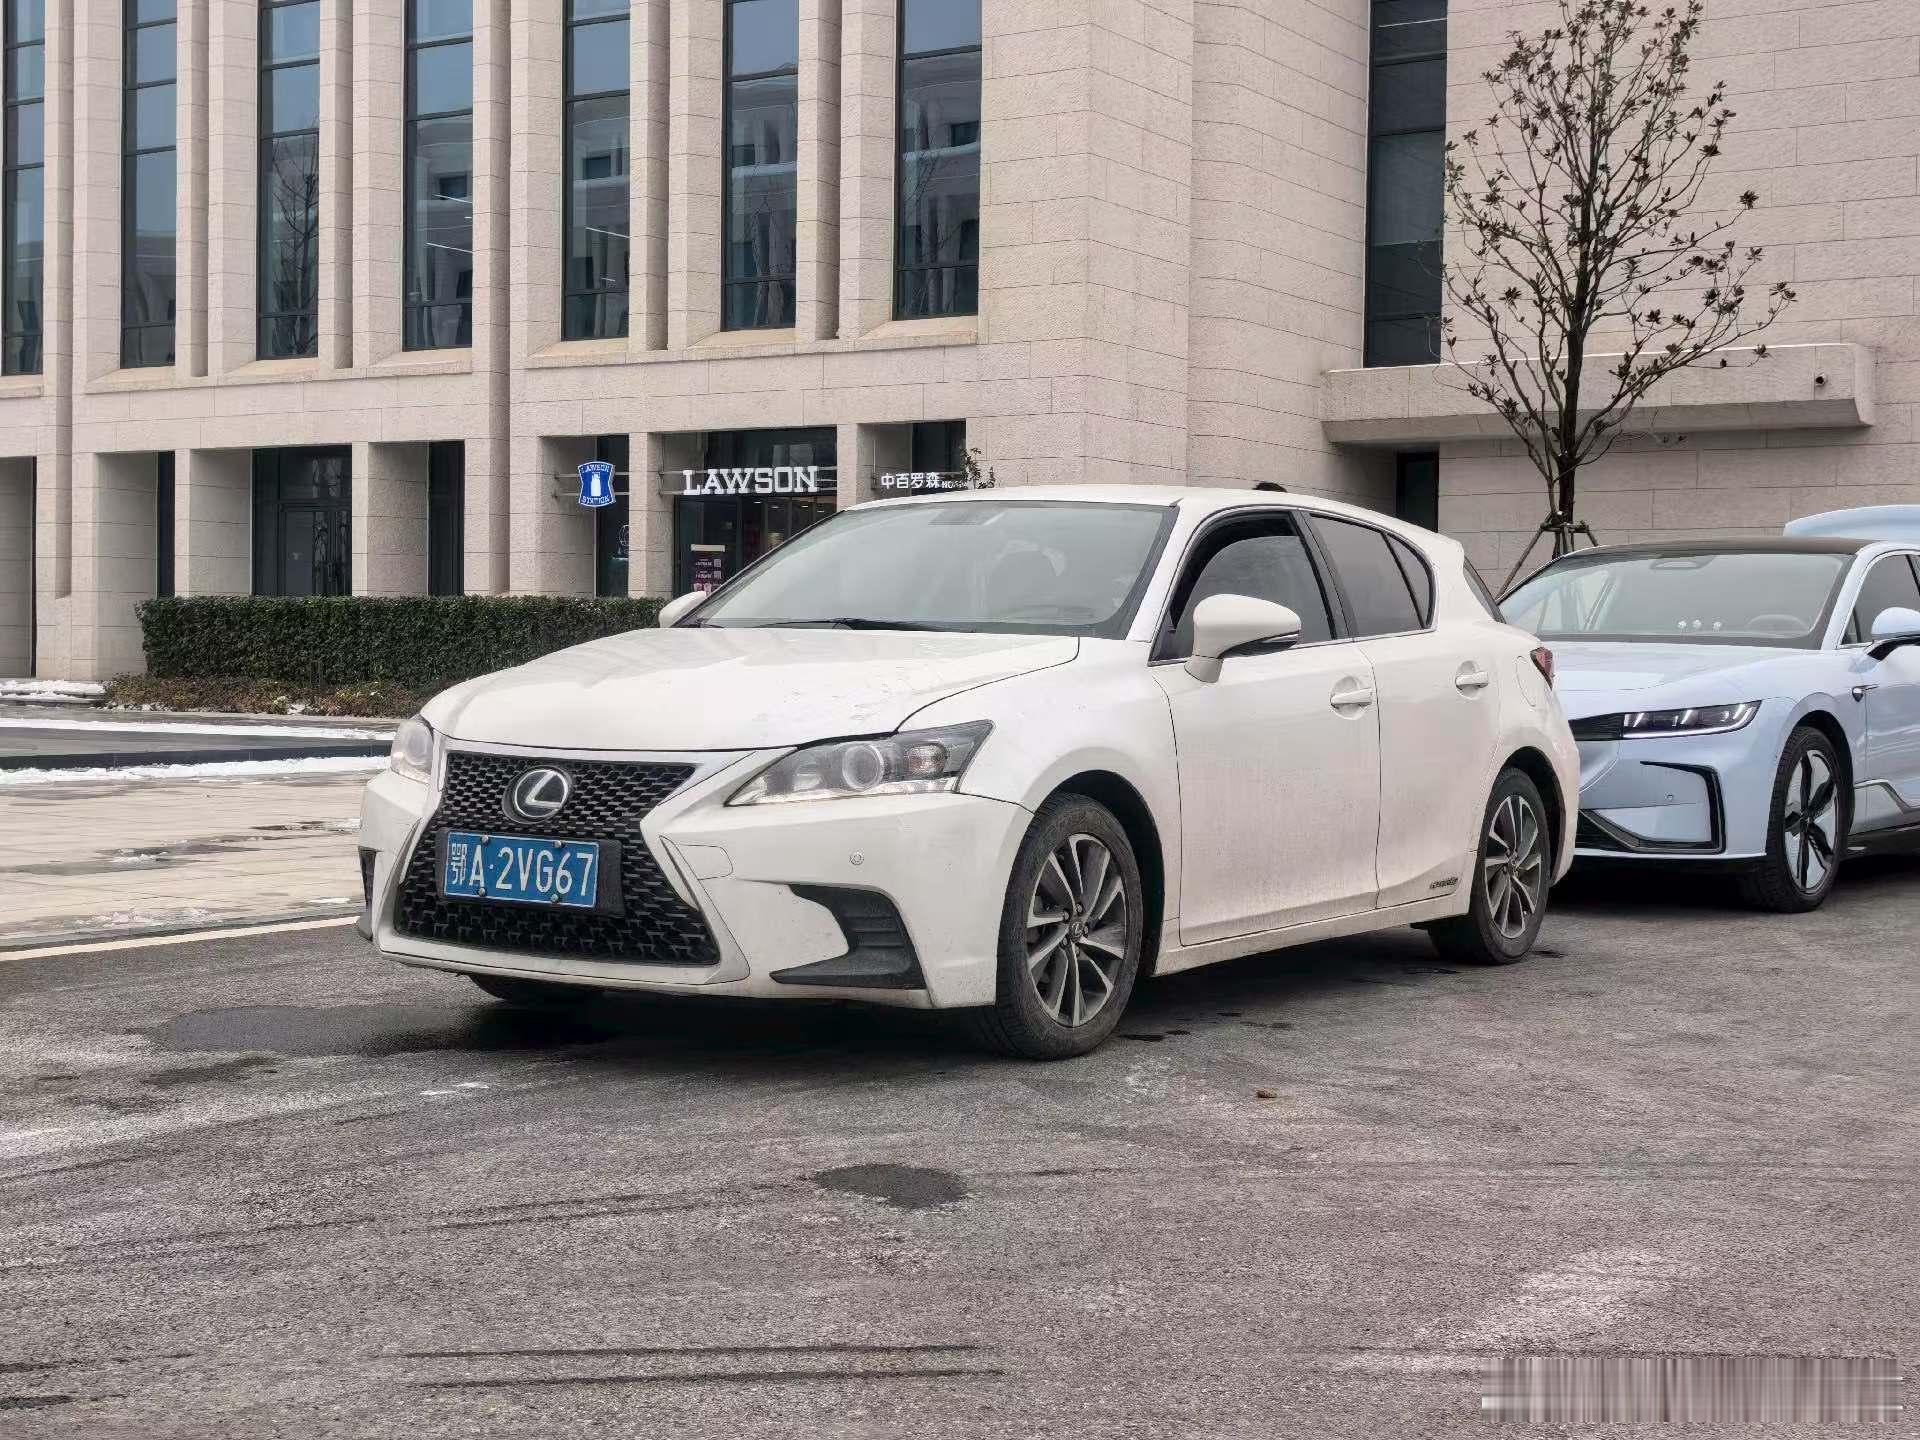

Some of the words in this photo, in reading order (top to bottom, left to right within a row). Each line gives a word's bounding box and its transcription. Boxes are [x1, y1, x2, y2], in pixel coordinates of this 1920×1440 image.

[682, 465, 818, 495] LAWSON
[881, 472, 939, 489] 中百罗森
